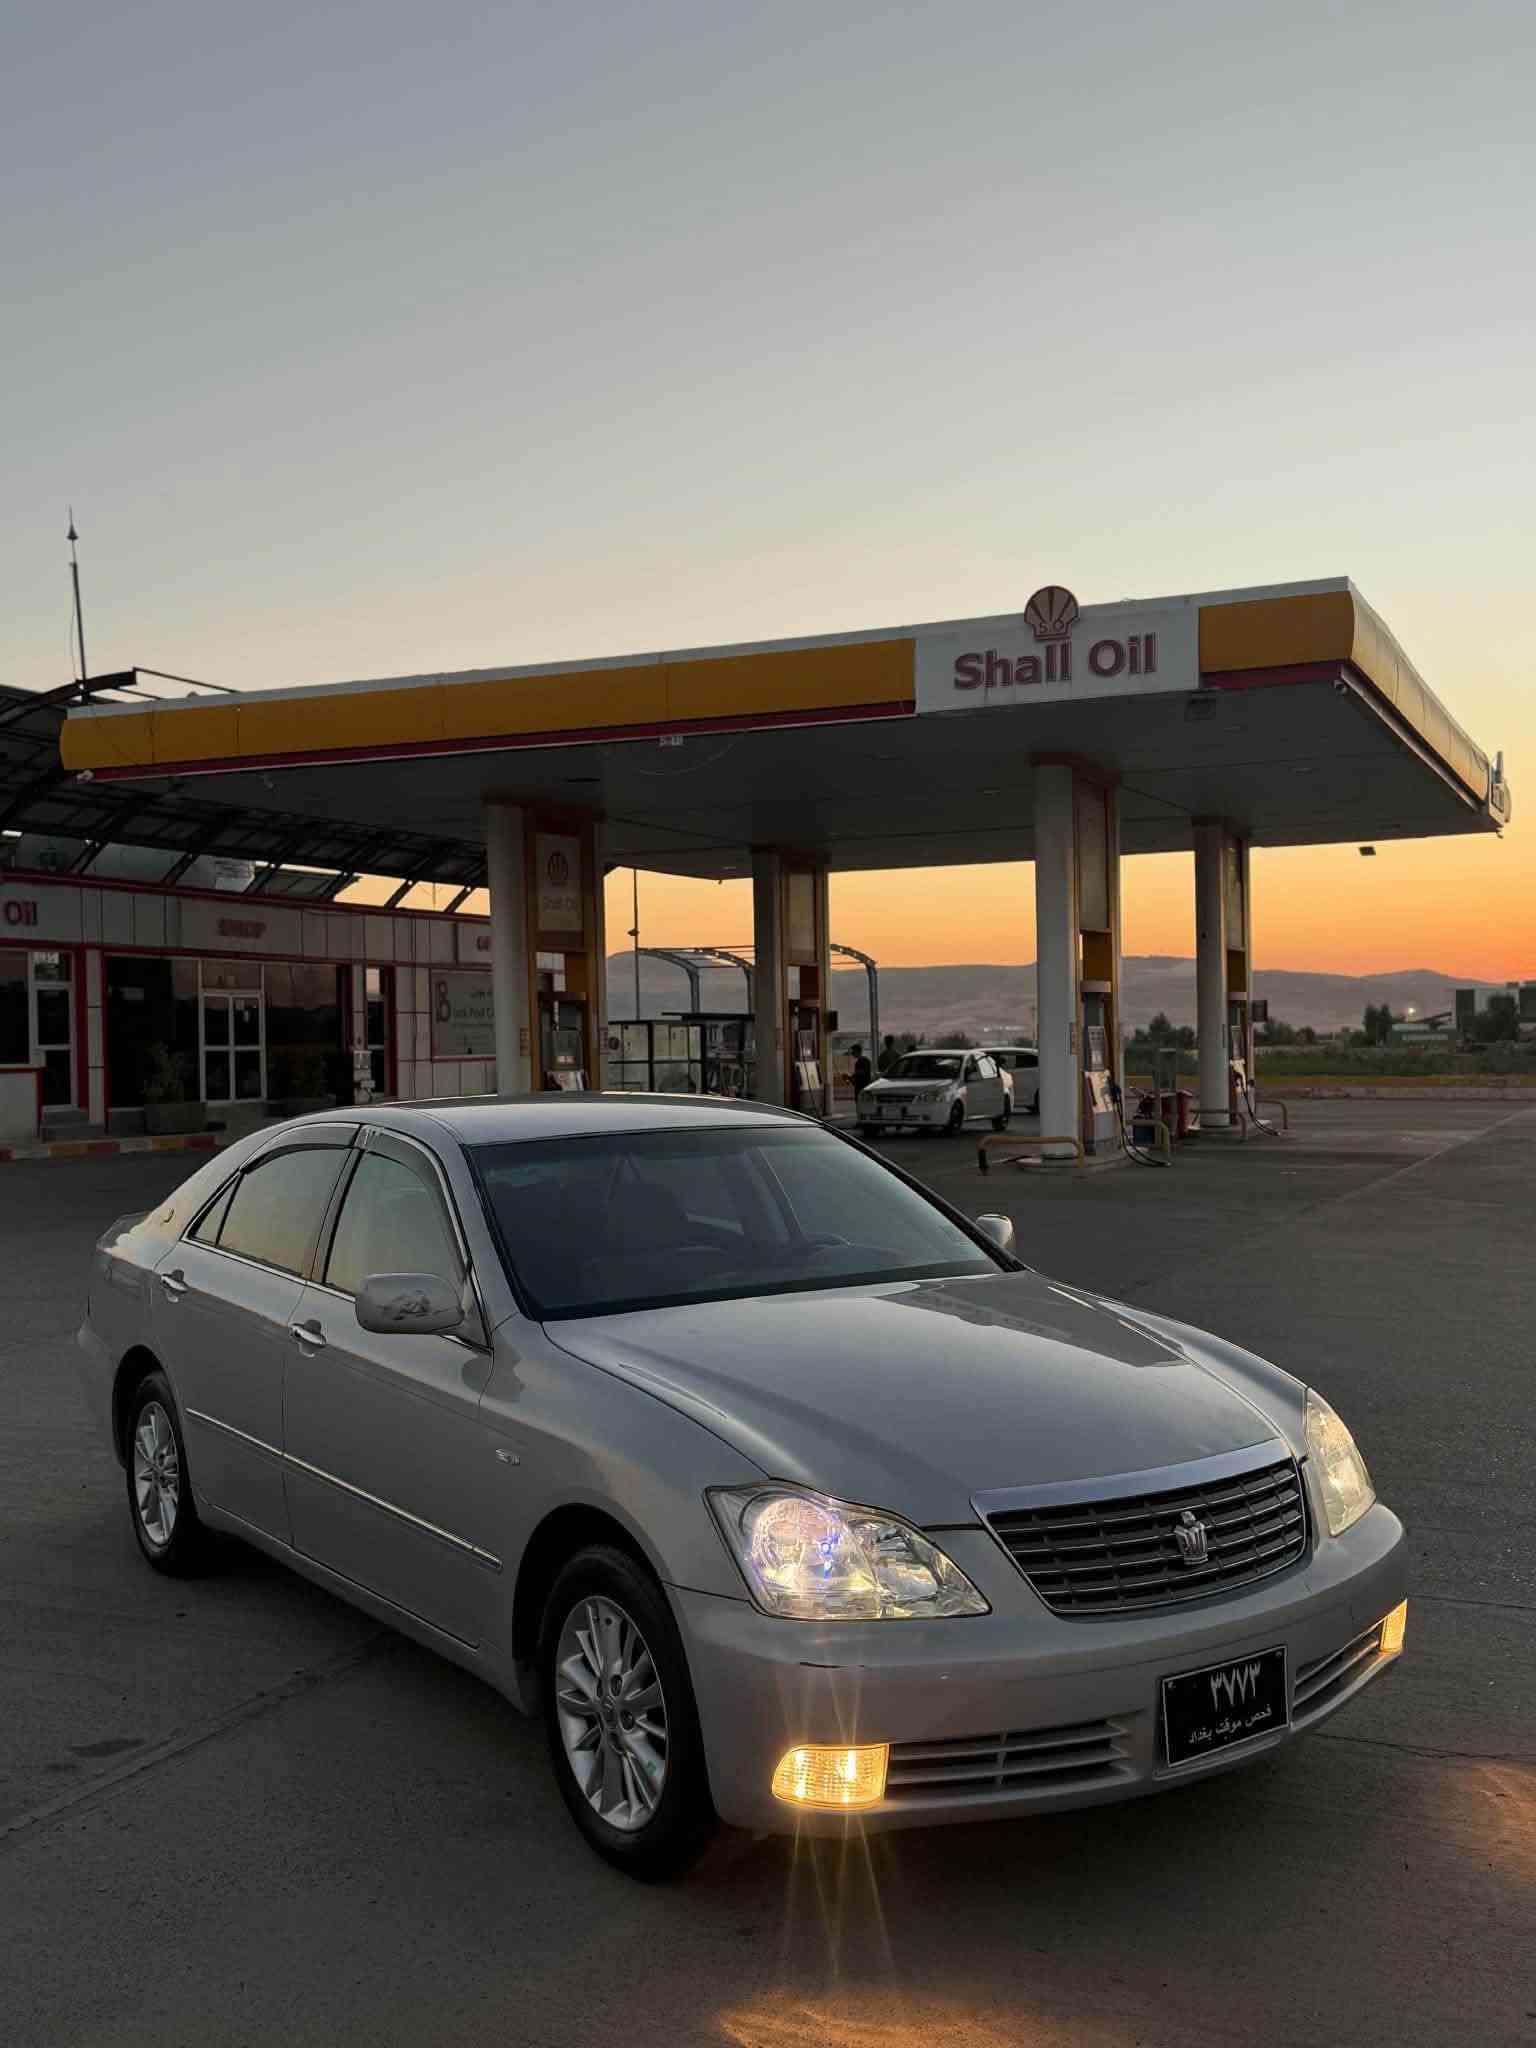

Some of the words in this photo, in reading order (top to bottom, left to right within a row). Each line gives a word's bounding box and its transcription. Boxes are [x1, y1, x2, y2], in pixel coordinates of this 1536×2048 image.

[954, 642, 1072, 690] Shall
[1088, 634, 1159, 677] Oil
[5, 902, 38, 926] Oil
[1246, 1704, 1272, 1727] فحص
